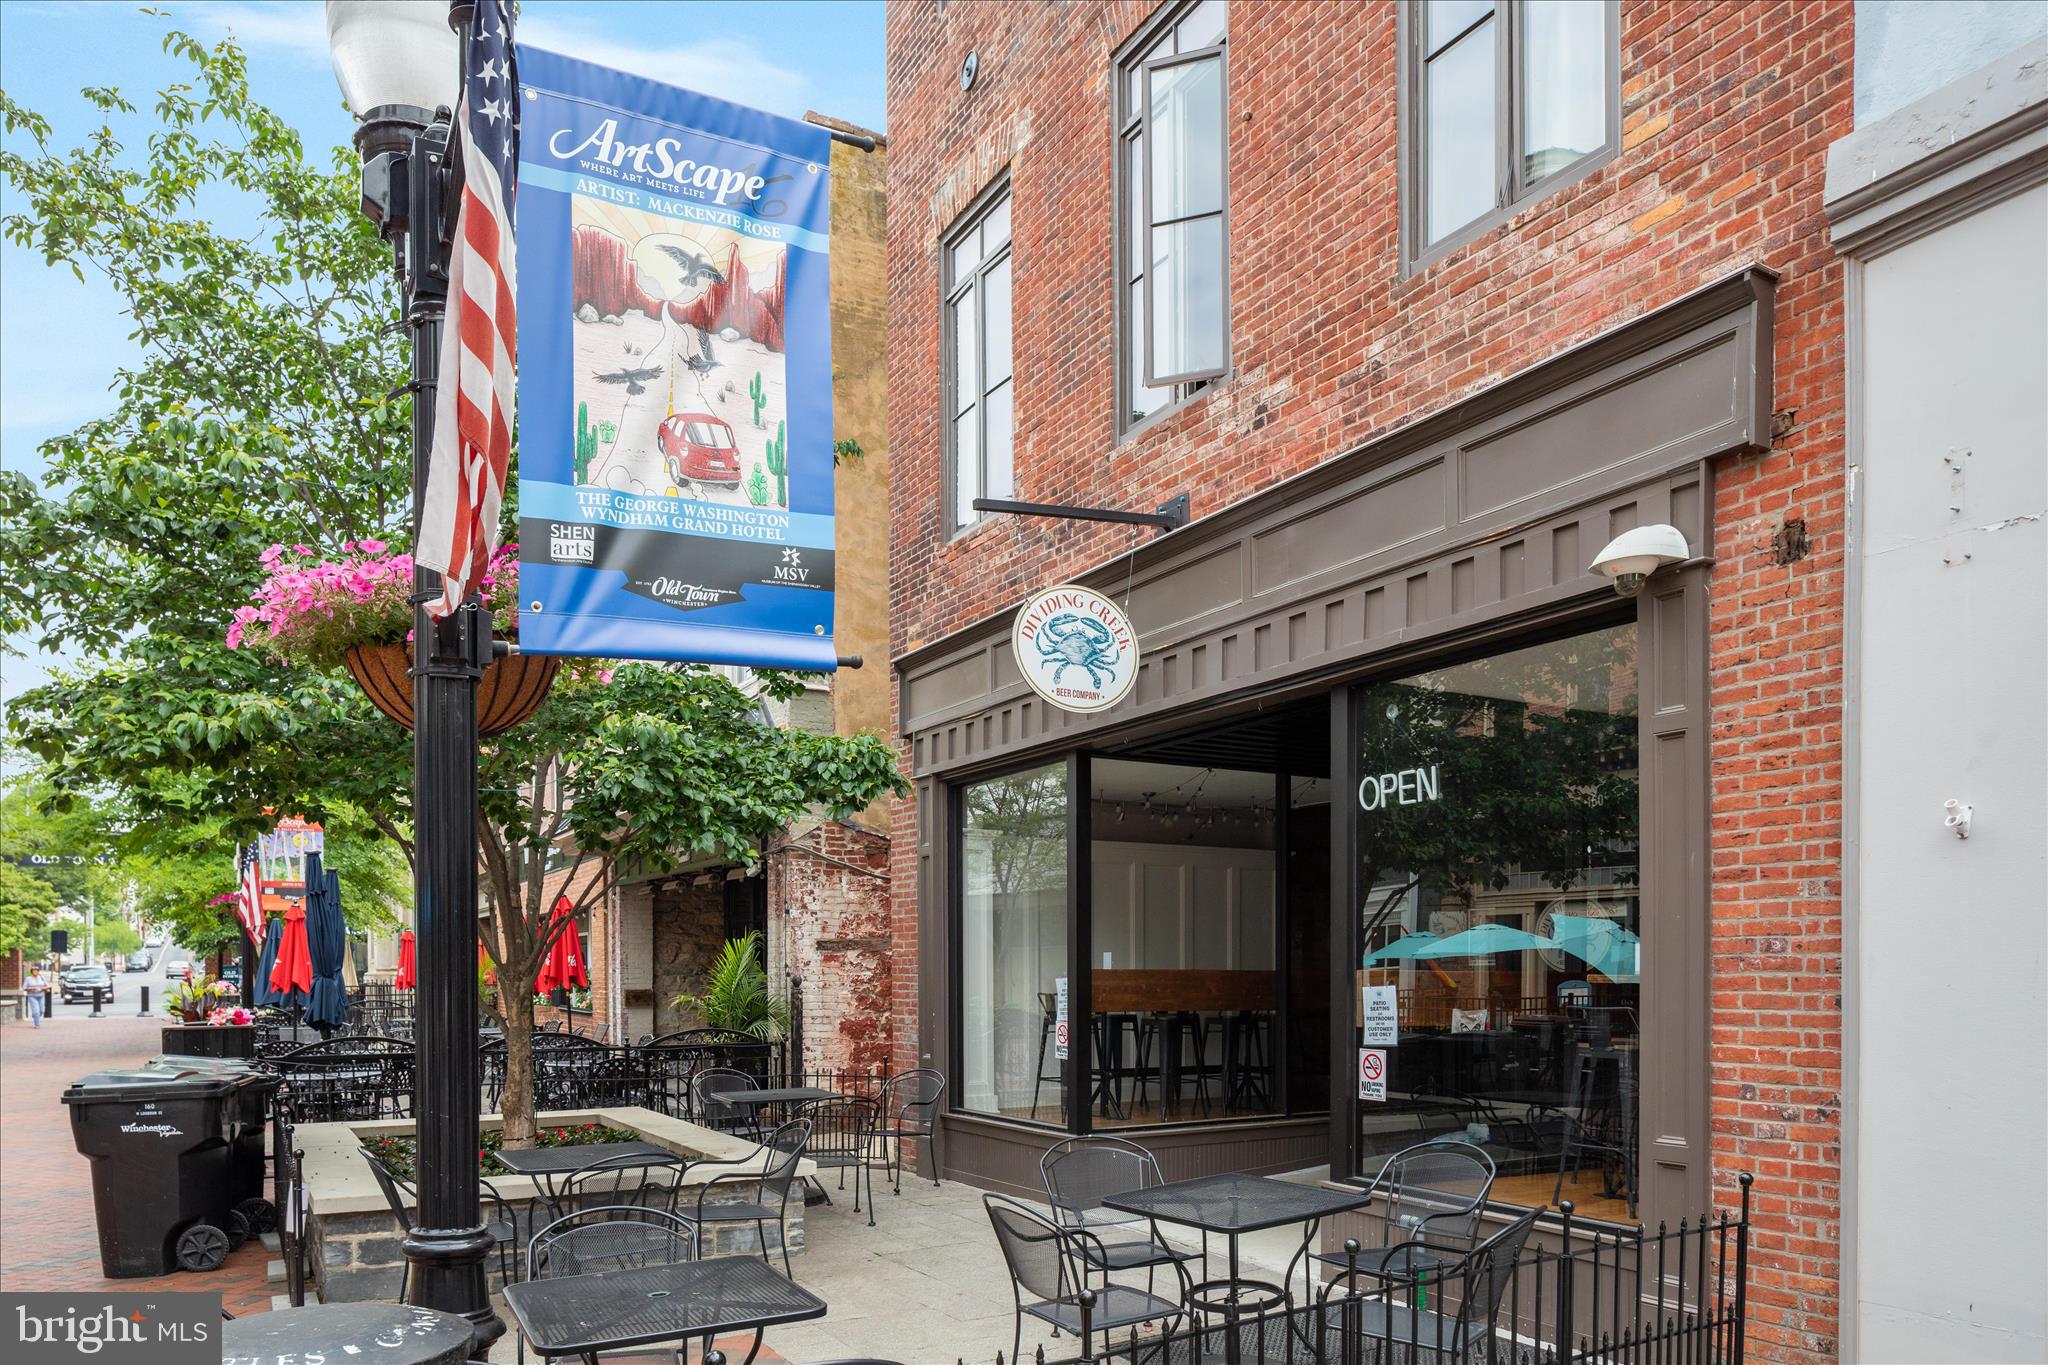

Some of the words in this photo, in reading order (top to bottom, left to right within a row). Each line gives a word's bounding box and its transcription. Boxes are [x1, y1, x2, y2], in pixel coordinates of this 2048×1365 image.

[549, 118, 765, 206] ArtScape
[580, 160, 619, 178] WHERE
[622, 172, 642, 184] ART
[646, 177, 680, 193] MEETS
[683, 187, 705, 199] LIFE
[576, 178, 640, 206] ARTIST:
[647, 197, 741, 229] MACKENZIE
[743, 218, 782, 239] ROSE
[576, 492, 610, 507] THE
[614, 496, 679, 515] GEORGE
[684, 505, 790, 528] WASHINGTON
[550, 523, 595, 540] SHEN
[581, 507, 669, 527] WYNDHAM
[672, 515, 728, 535] GRAND
[731, 525, 785, 541] HOTEL
[553, 541, 592, 558] arts
[774, 565, 810, 582] MSV
[651, 575, 680, 597] Old
[679, 584, 720, 602] Town
[666, 598, 705, 607] WINCHESTER
[1022, 593, 1084, 641] DIVIDING
[1089, 600, 1132, 652] CREEK
[1056, 687, 1072, 697] BEER
[1072, 689, 1101, 700] COMPANY
[1359, 765, 1438, 811] OPEN
[31, 854, 60, 864] OLD
[1362, 1081, 1371, 1092] NO
[120, 1122, 171, 1132] Winchester
